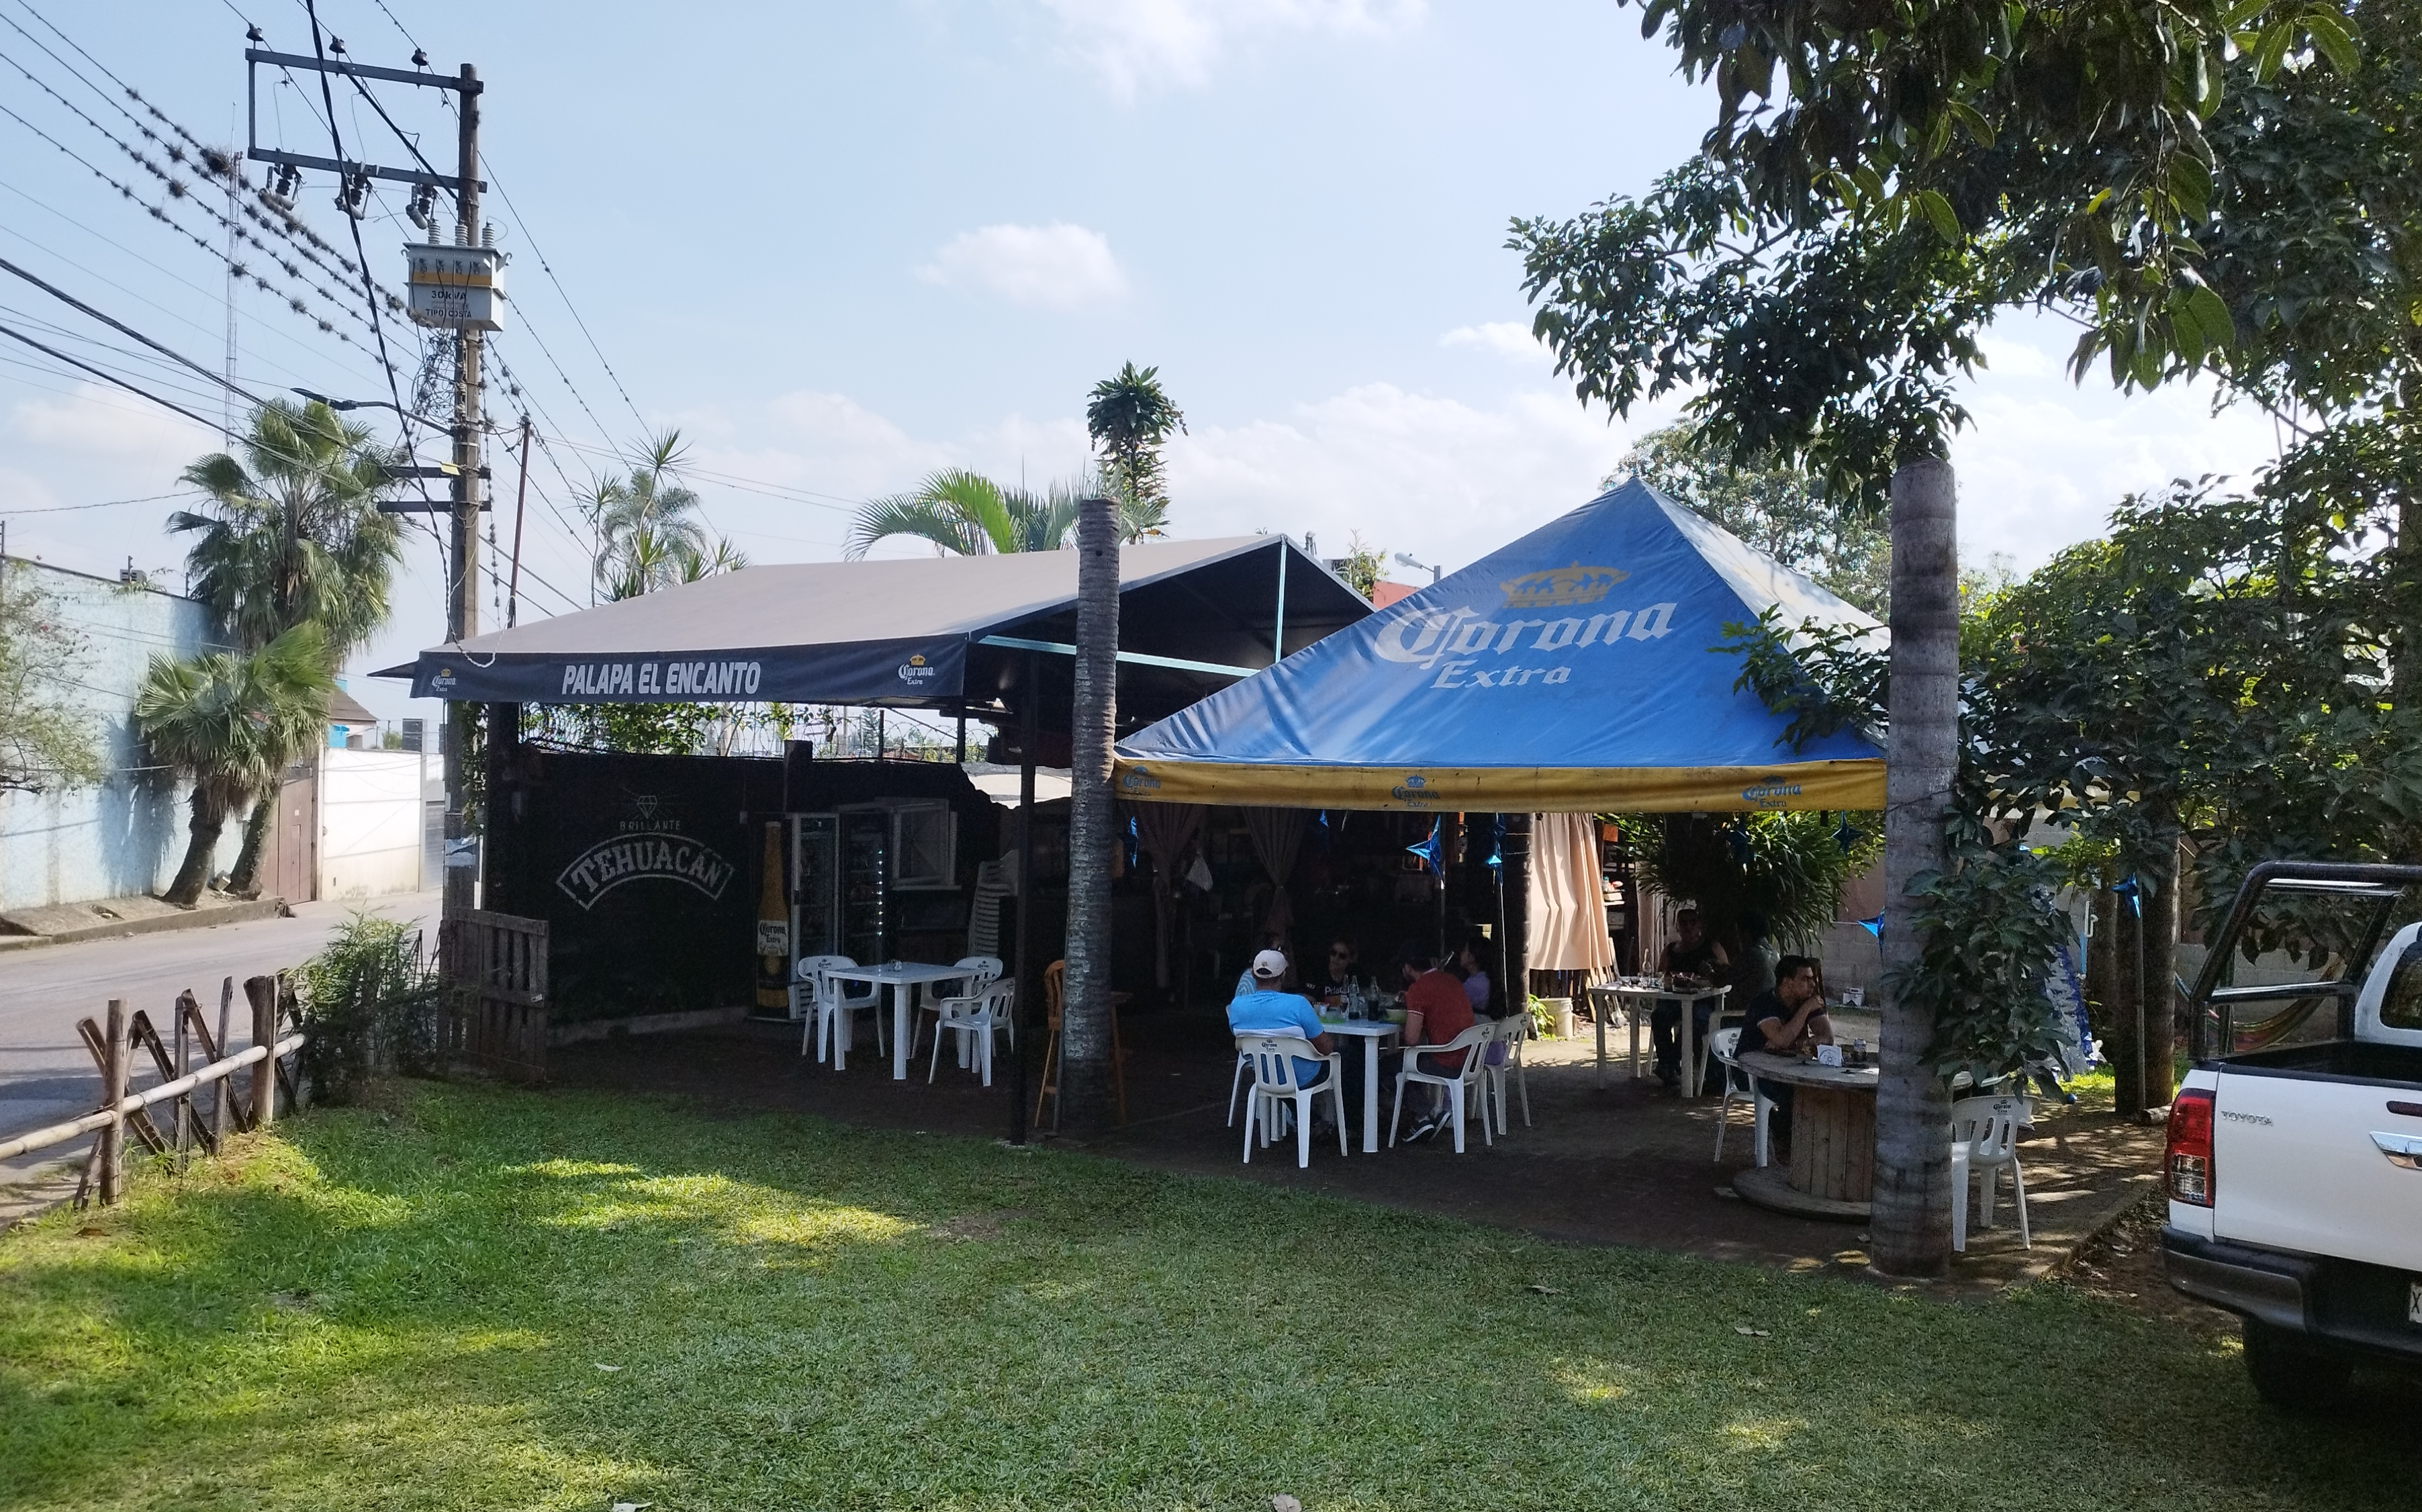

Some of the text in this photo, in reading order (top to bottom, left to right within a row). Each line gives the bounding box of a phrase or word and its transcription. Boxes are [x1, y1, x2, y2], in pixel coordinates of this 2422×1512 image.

[426, 308, 471, 318] TIPO COSTA
[1375, 602, 1677, 669] Corona
[561, 662, 761, 694] PALAPA EL ENCANTO
[898, 663, 935, 680] Corona
[1429, 659, 1573, 689] Extra
[432, 675, 456, 688] Corona
[906, 677, 923, 685] Extra
[1391, 786, 1440, 800] Corona
[1741, 785, 1802, 801] Corona
[1758, 798, 1787, 808] Extra
[620, 820, 680, 831] BRILLANTE
[759, 923, 786, 936] Corona
[2221, 1110, 2274, 1127] TOYOTA
